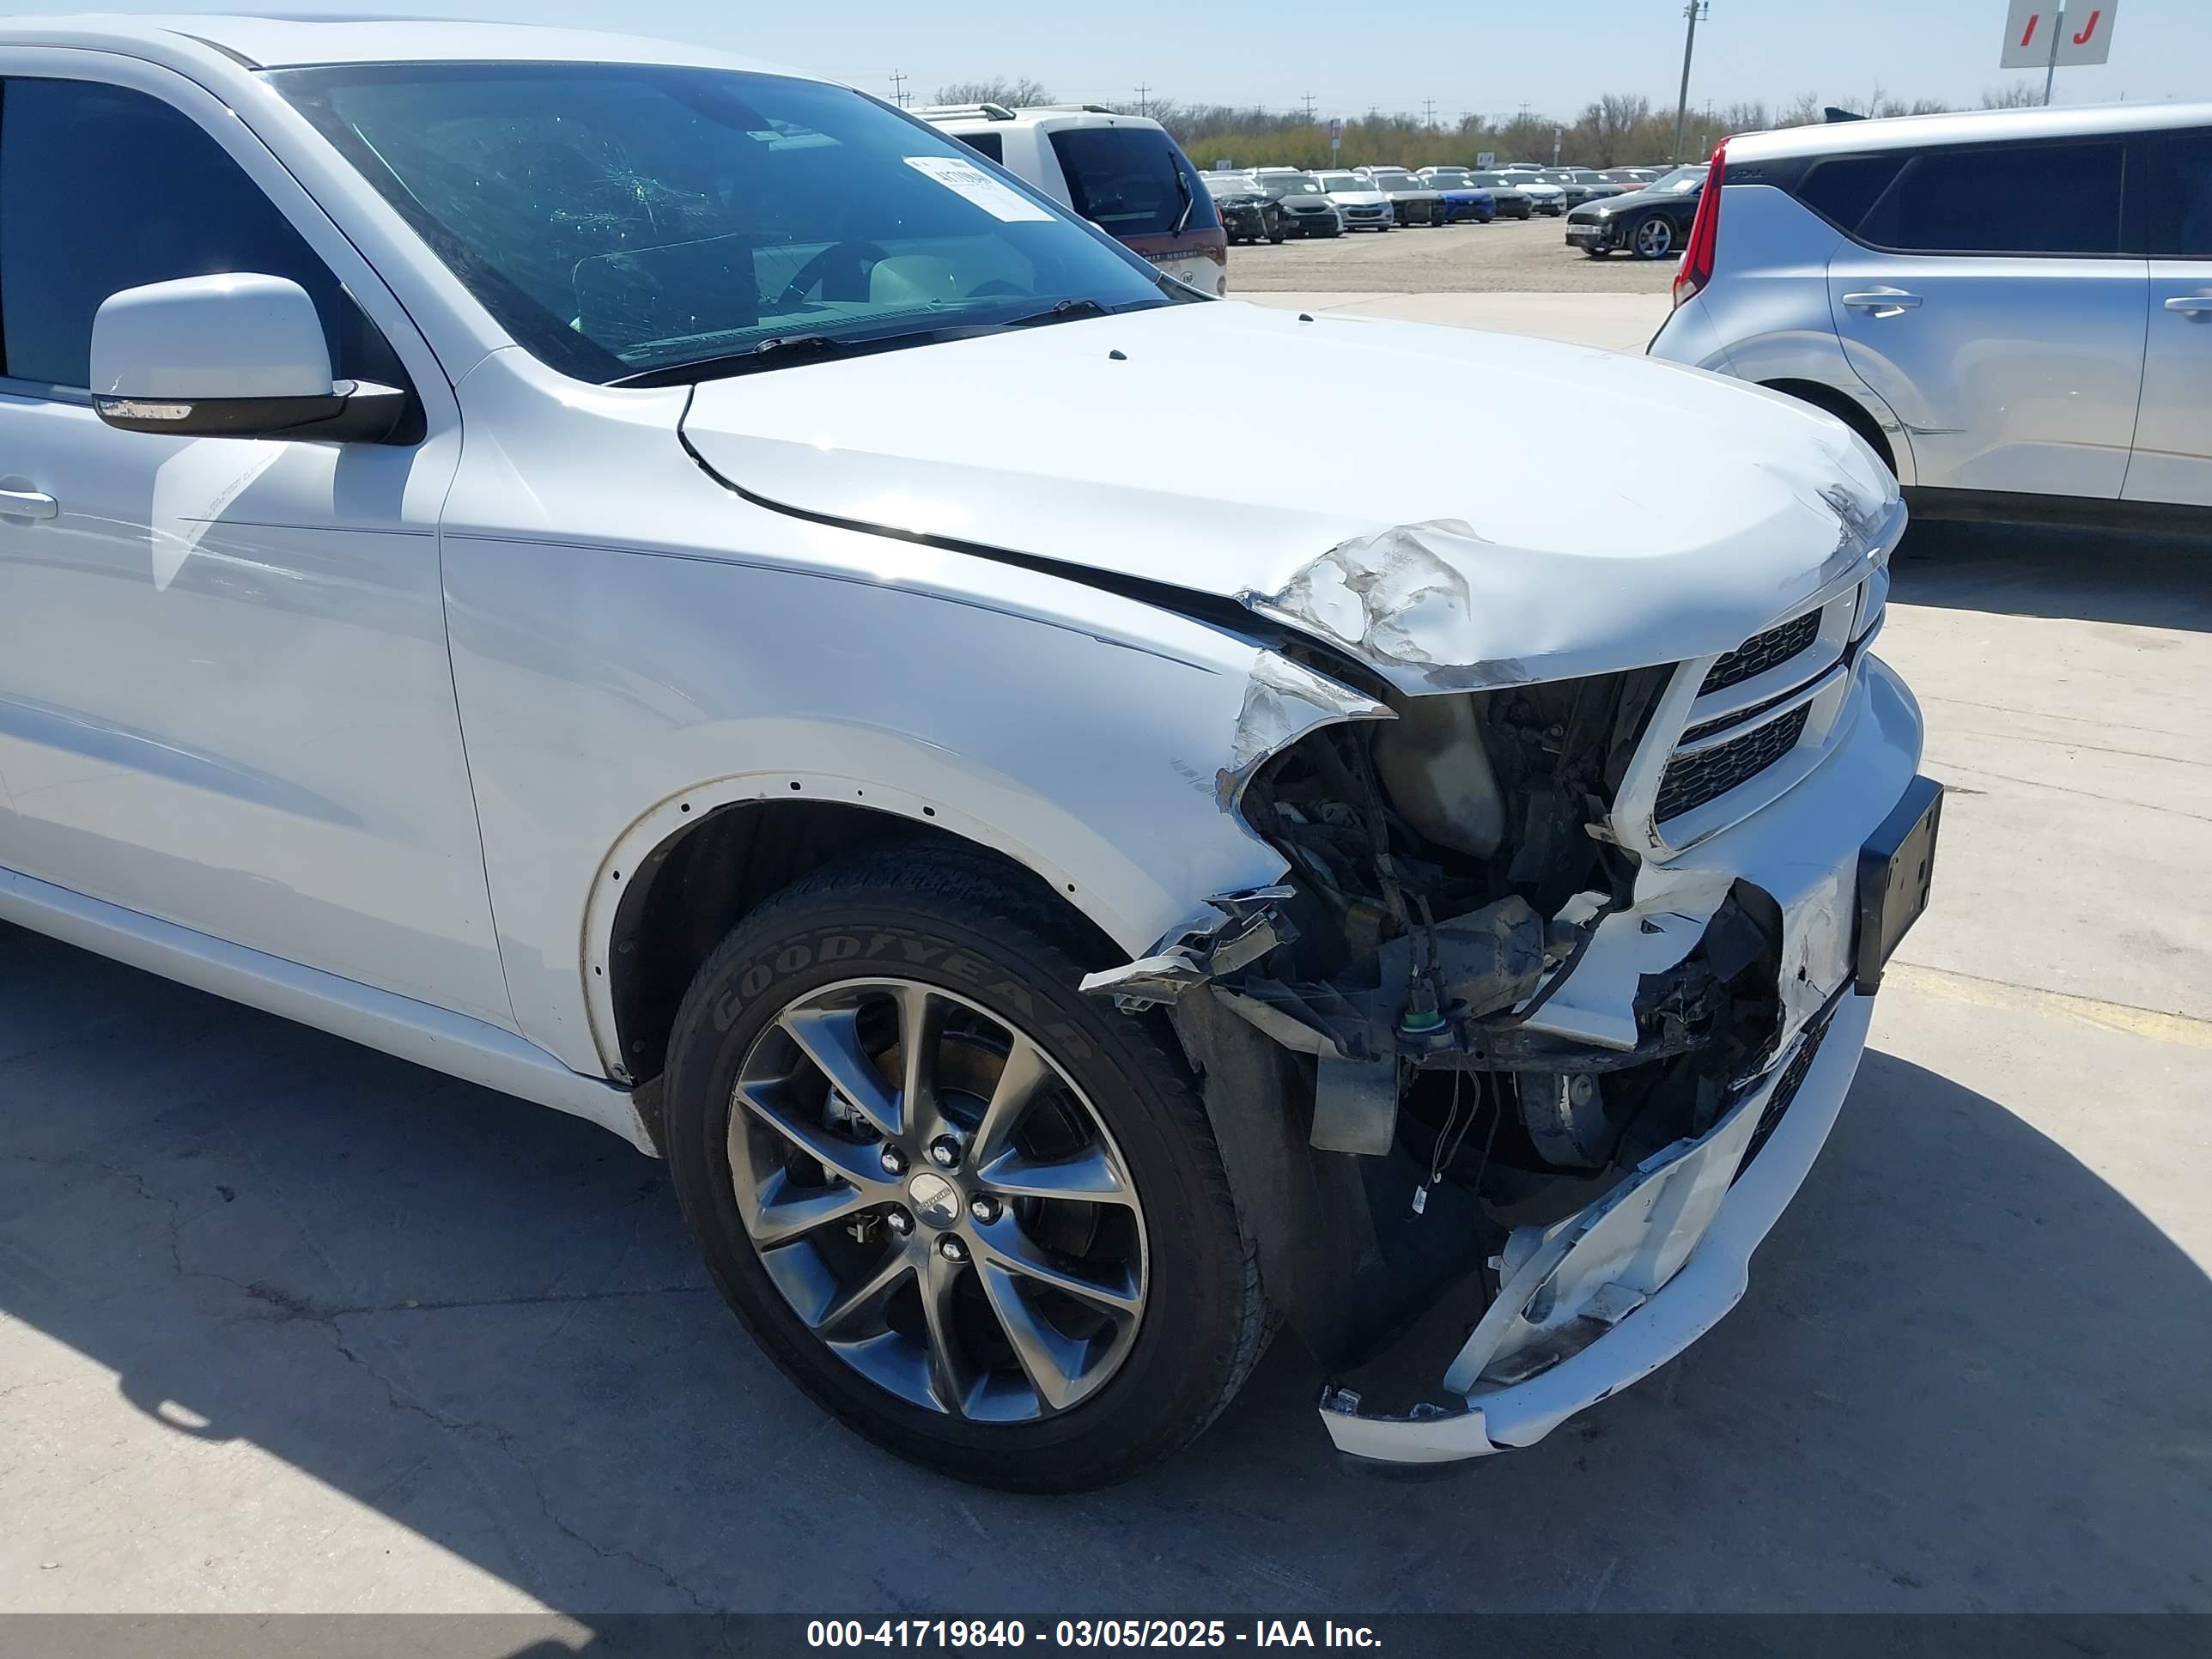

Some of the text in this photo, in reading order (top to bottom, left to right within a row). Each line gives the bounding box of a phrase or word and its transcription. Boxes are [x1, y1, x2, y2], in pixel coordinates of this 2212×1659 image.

[2073, 10, 2101, 45] J
[712, 934, 1093, 1060] GOODYEAR
[915, 1188, 951, 1212] DODGE
